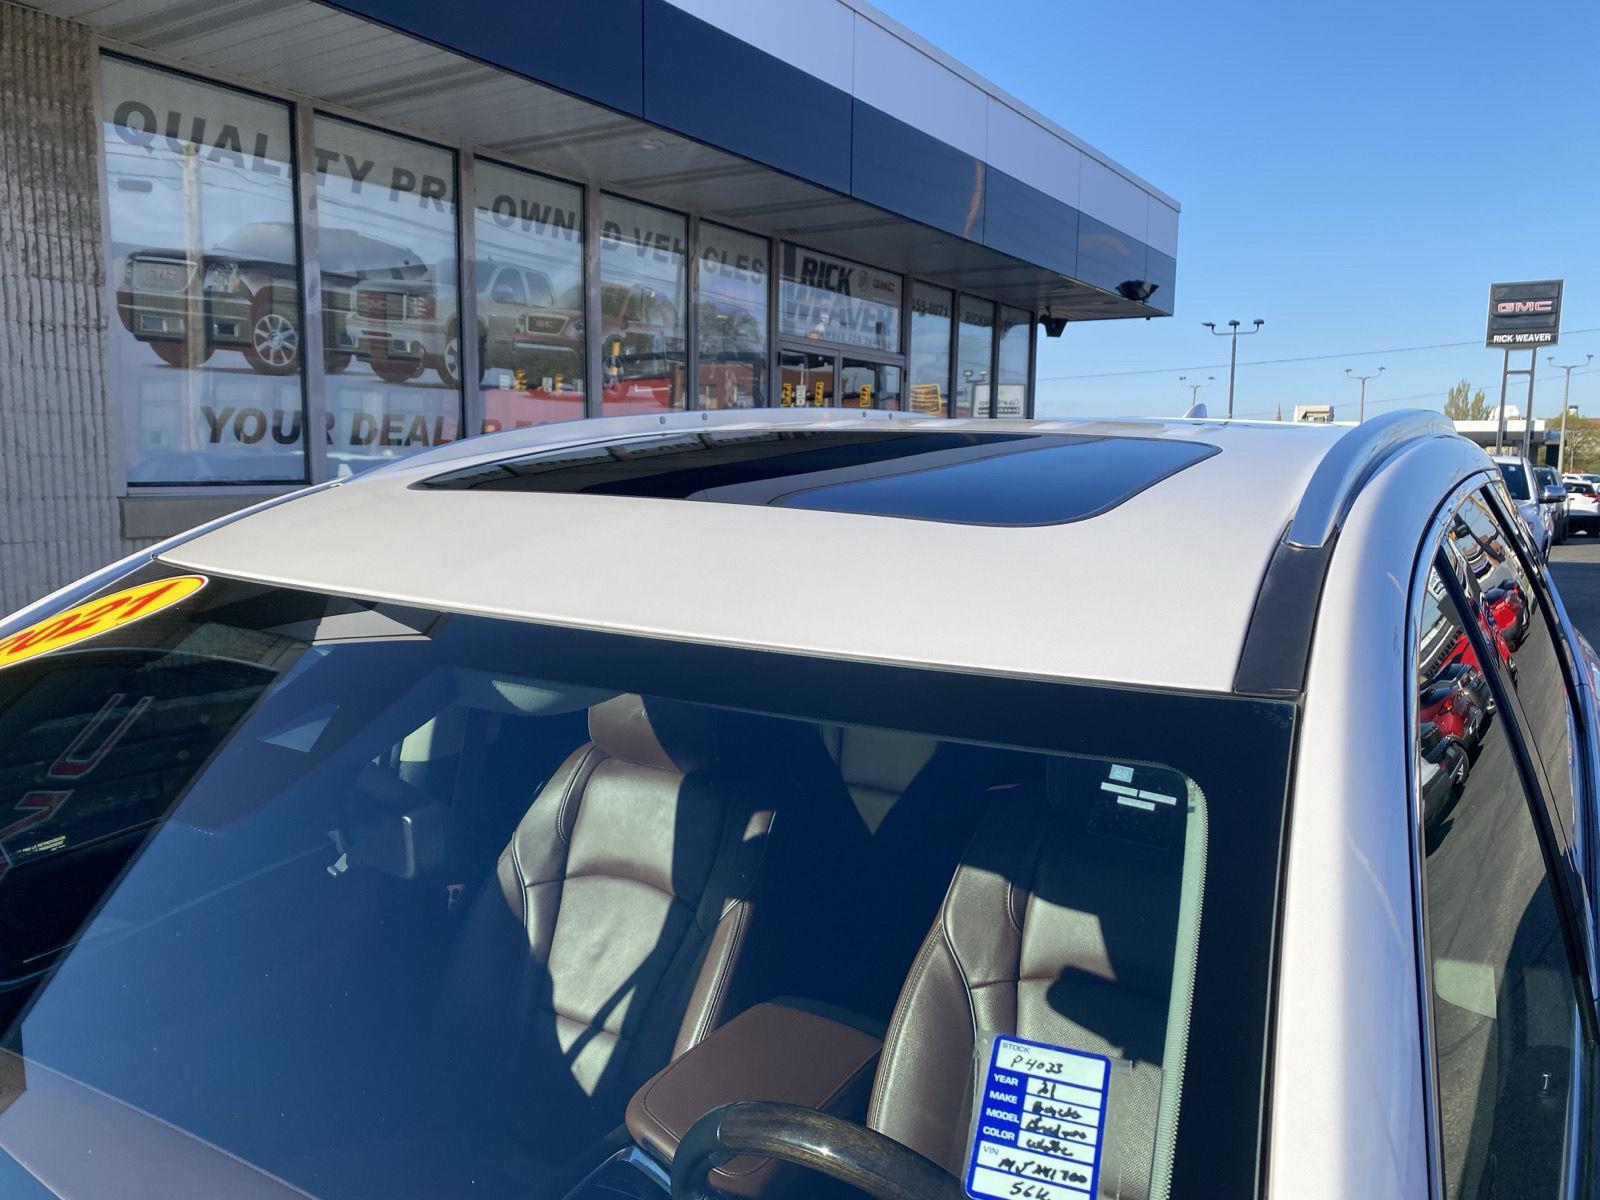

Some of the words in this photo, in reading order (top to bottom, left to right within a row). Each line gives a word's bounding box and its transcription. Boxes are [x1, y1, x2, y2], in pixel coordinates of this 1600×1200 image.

[113, 101, 375, 195] QUALTY
[388, 165, 622, 251] PR-OWND
[633, 226, 764, 285] VEHCLES
[800, 256, 856, 297] RICK
[872, 278, 896, 292] GMC
[1497, 301, 1552, 313] GMC
[1493, 334, 1513, 343] RICK
[1515, 334, 1551, 342] WEAVER
[1002, 1042, 1030, 1054] STOCK
[993, 1073, 1019, 1087] YEAR
[989, 1090, 1018, 1104] MAKE
[986, 1107, 1020, 1124] MODEL
[982, 1125, 1016, 1141] COLOR
[983, 1145, 999, 1156] VIN
